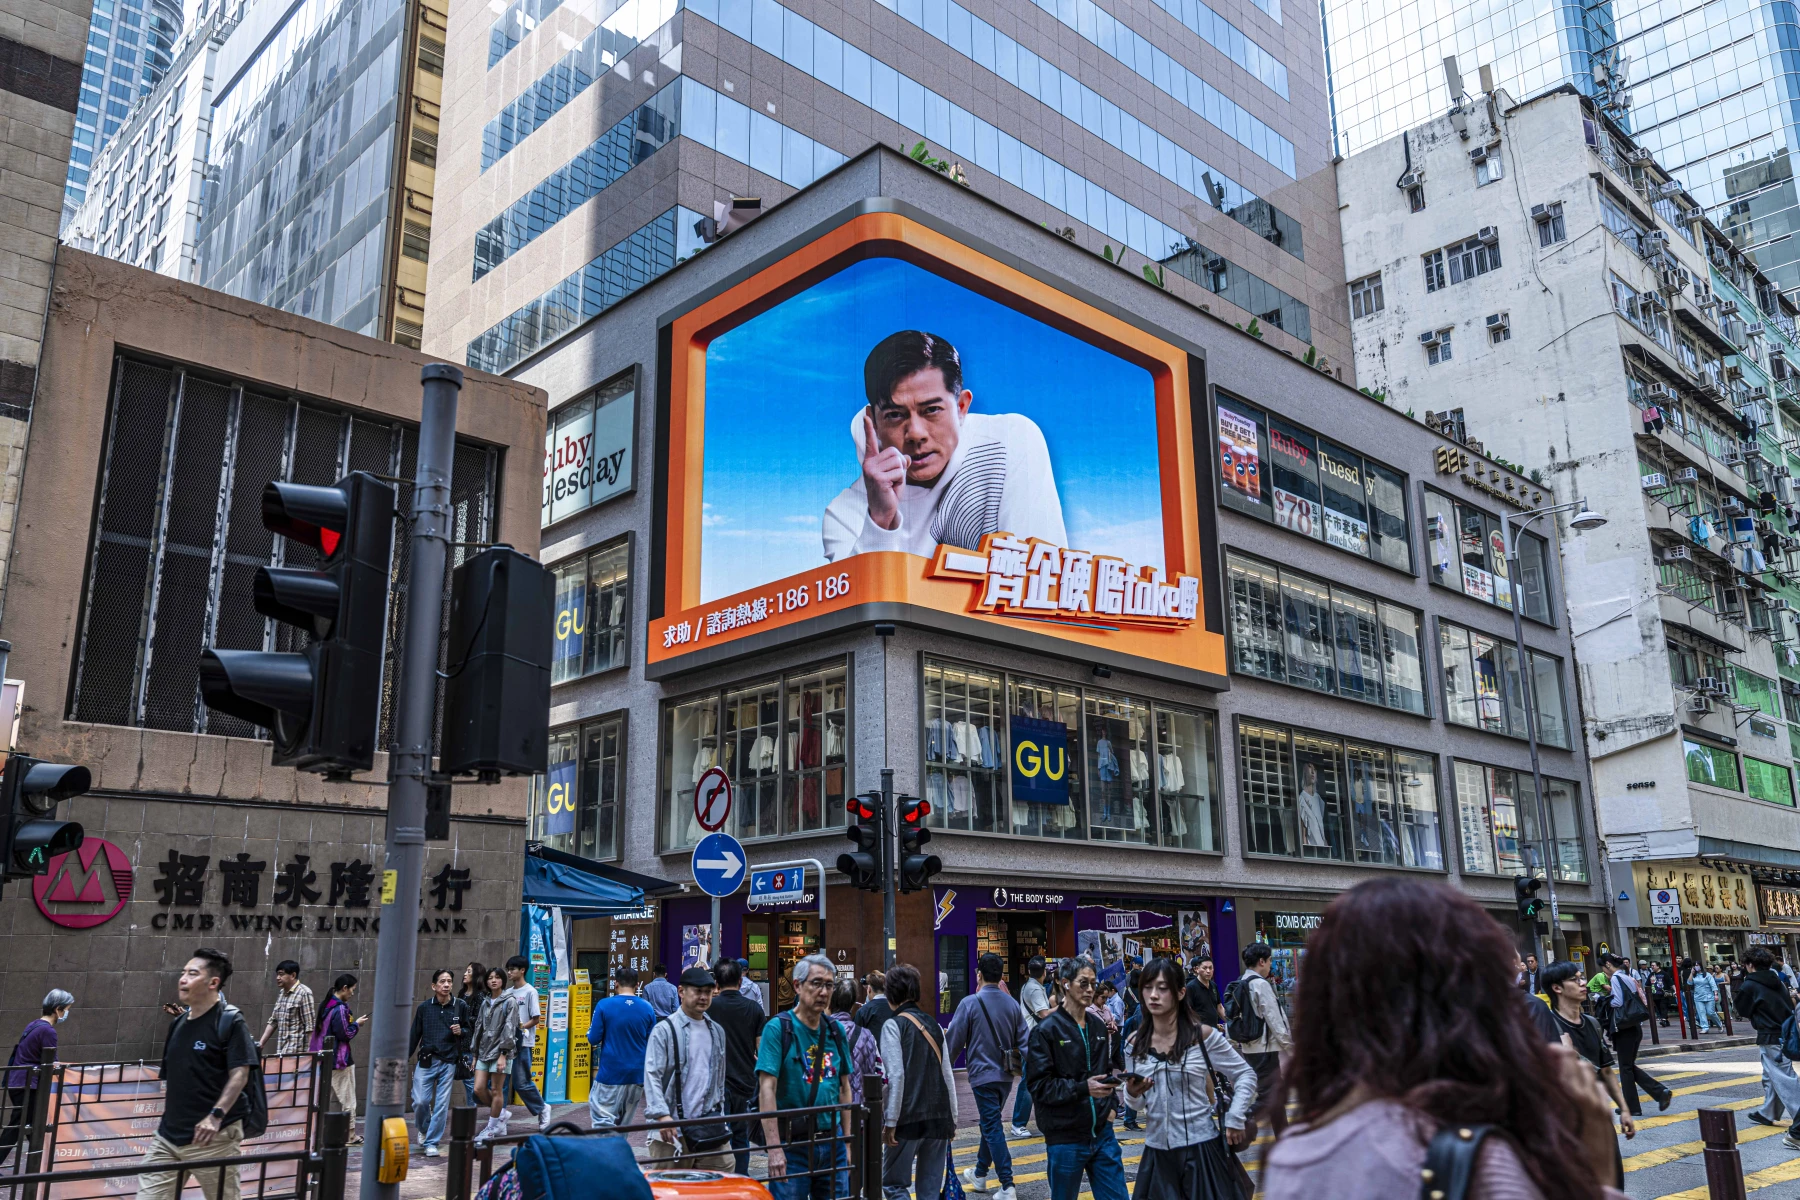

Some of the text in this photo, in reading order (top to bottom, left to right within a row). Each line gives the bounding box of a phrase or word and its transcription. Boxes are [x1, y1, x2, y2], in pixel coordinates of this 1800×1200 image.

[1220, 419, 1233, 429] BUY
[1234, 424, 1239, 432] 2
[1239, 427, 1251, 438] GET
[1220, 427, 1236, 439] FREE
[1269, 428, 1375, 496] Ruby Tuesdy
[542, 448, 626, 508] uesday
[1274, 489, 1313, 536] $78
[1324, 511, 1361, 539] 午市套餐
[1326, 528, 1348, 549] Lunch
[662, 620, 691, 648] 求助
[815, 572, 850, 603] 186
[555, 610, 585, 642] GU
[1474, 670, 1499, 698] GU
[1015, 740, 1065, 781] GU
[1626, 779, 1656, 790] sense
[546, 782, 576, 815] GU
[1490, 809, 1511, 837] GU
[153, 849, 472, 911] 招商永隆行
[1010, 893, 1064, 904] THE BODY SHOP
[151, 912, 215, 931] CMB
[230, 914, 304, 932] WING
[417, 918, 468, 934] ANK
[789, 921, 803, 932] FACE
[1107, 914, 1139, 929] BOLD THEN.
[1275, 914, 1300, 929] BOMB
[1671, 916, 1680, 924] 12
[1691, 912, 1713, 927] PHOTO
[1713, 913, 1740, 928] SUPPLIES
[630, 934, 650, 950] 兌換
[1126, 939, 1138, 956] IT'S
[630, 956, 649, 972] 匯款
